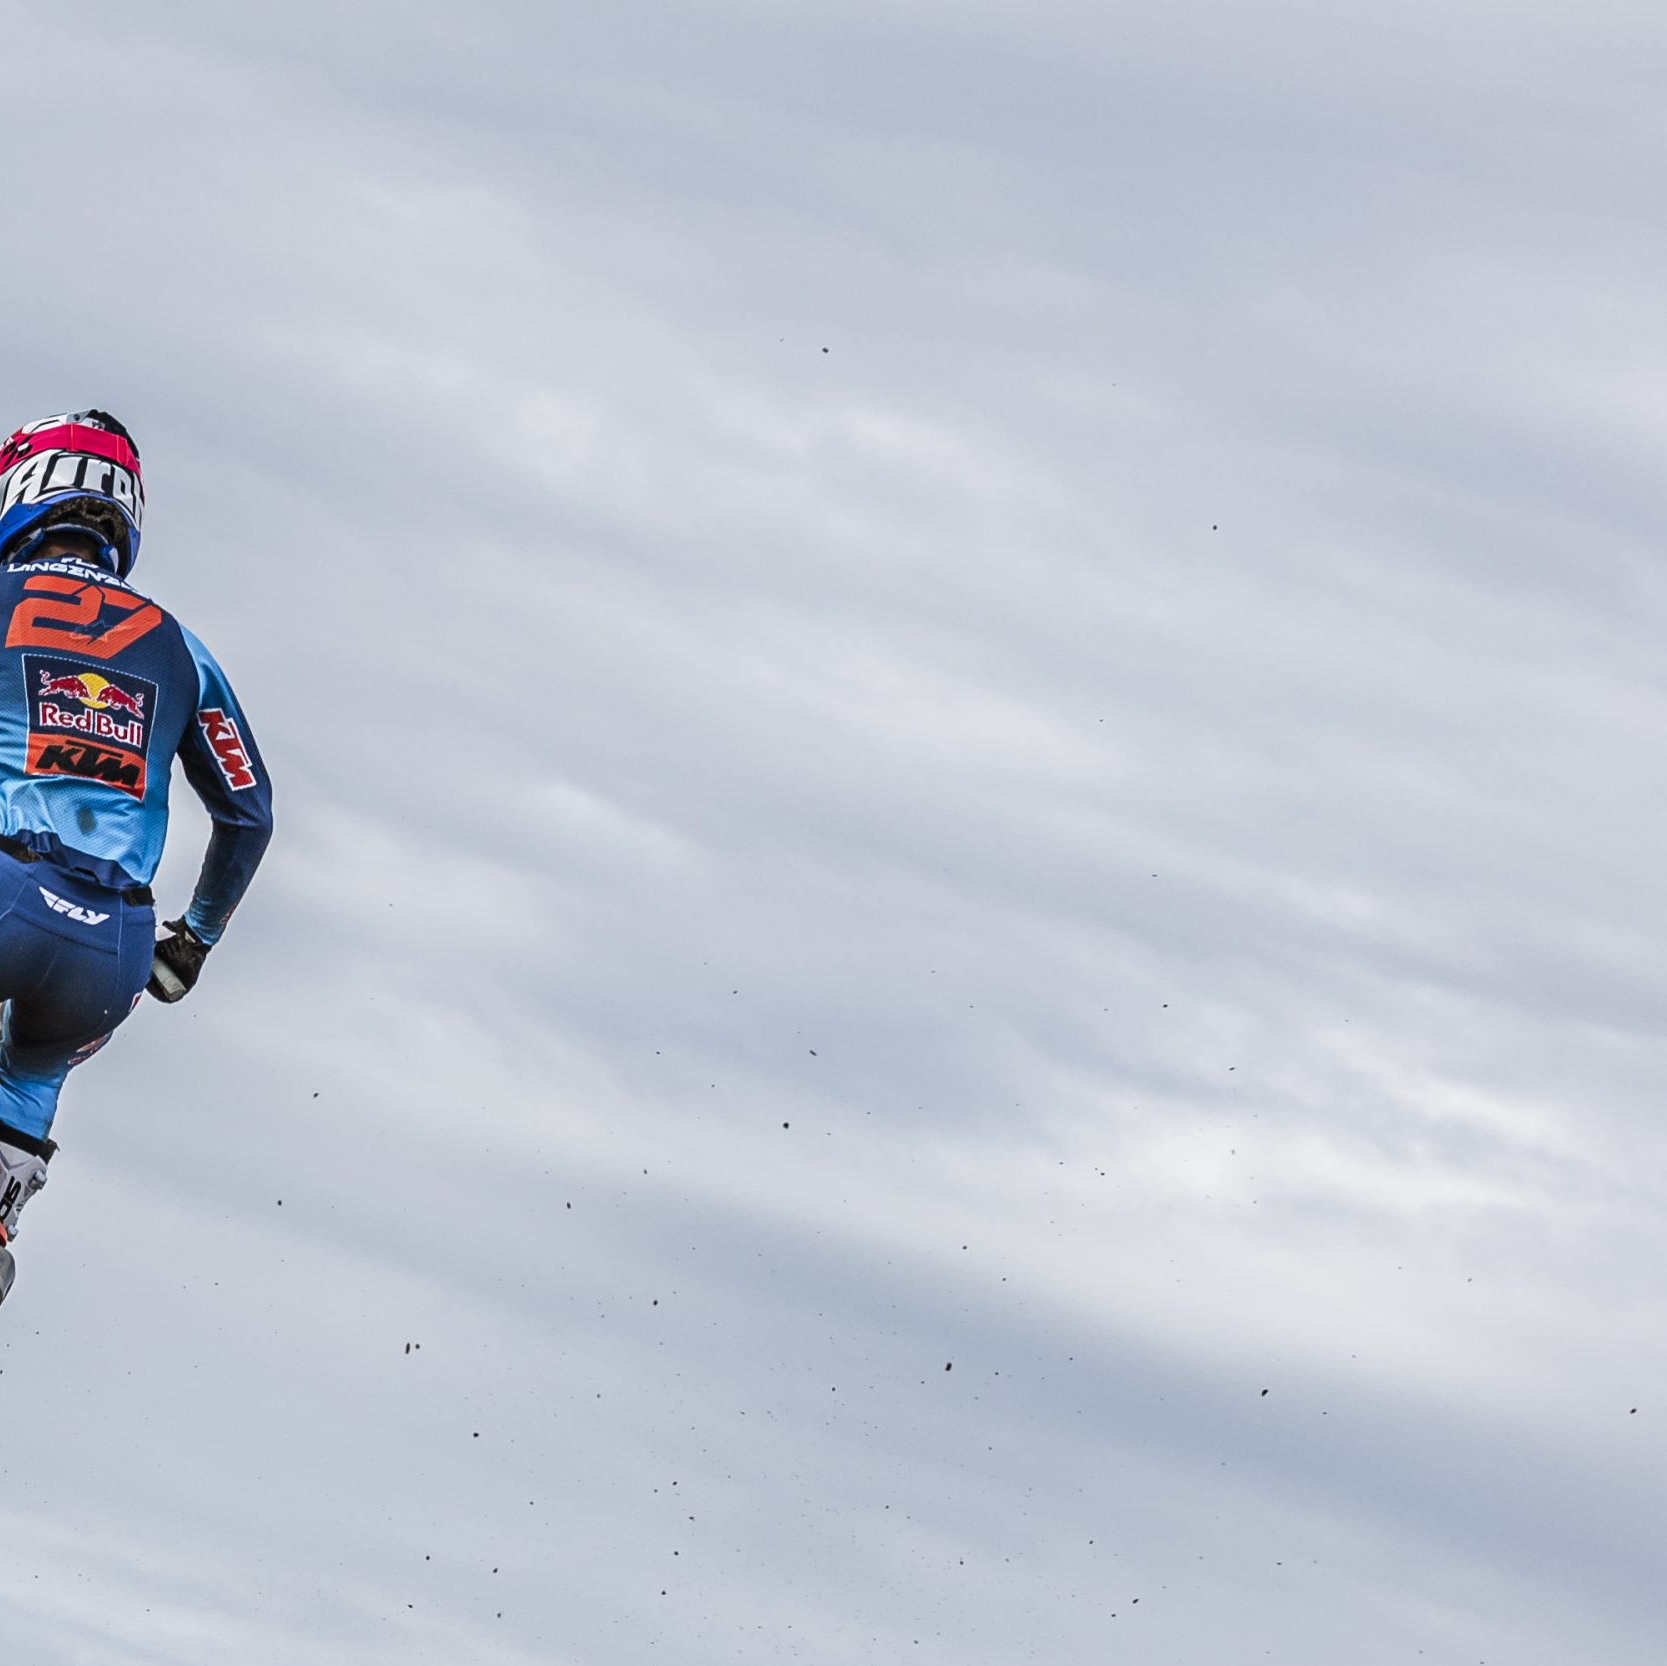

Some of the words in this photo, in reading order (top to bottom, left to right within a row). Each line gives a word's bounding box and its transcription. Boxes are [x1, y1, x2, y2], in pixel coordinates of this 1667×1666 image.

[5, 575, 162, 659] 27
[39, 702, 93, 733] Red
[94, 711, 143, 748] Bull
[197, 707, 257, 791] KTM
[35, 740, 140, 788] KTM
